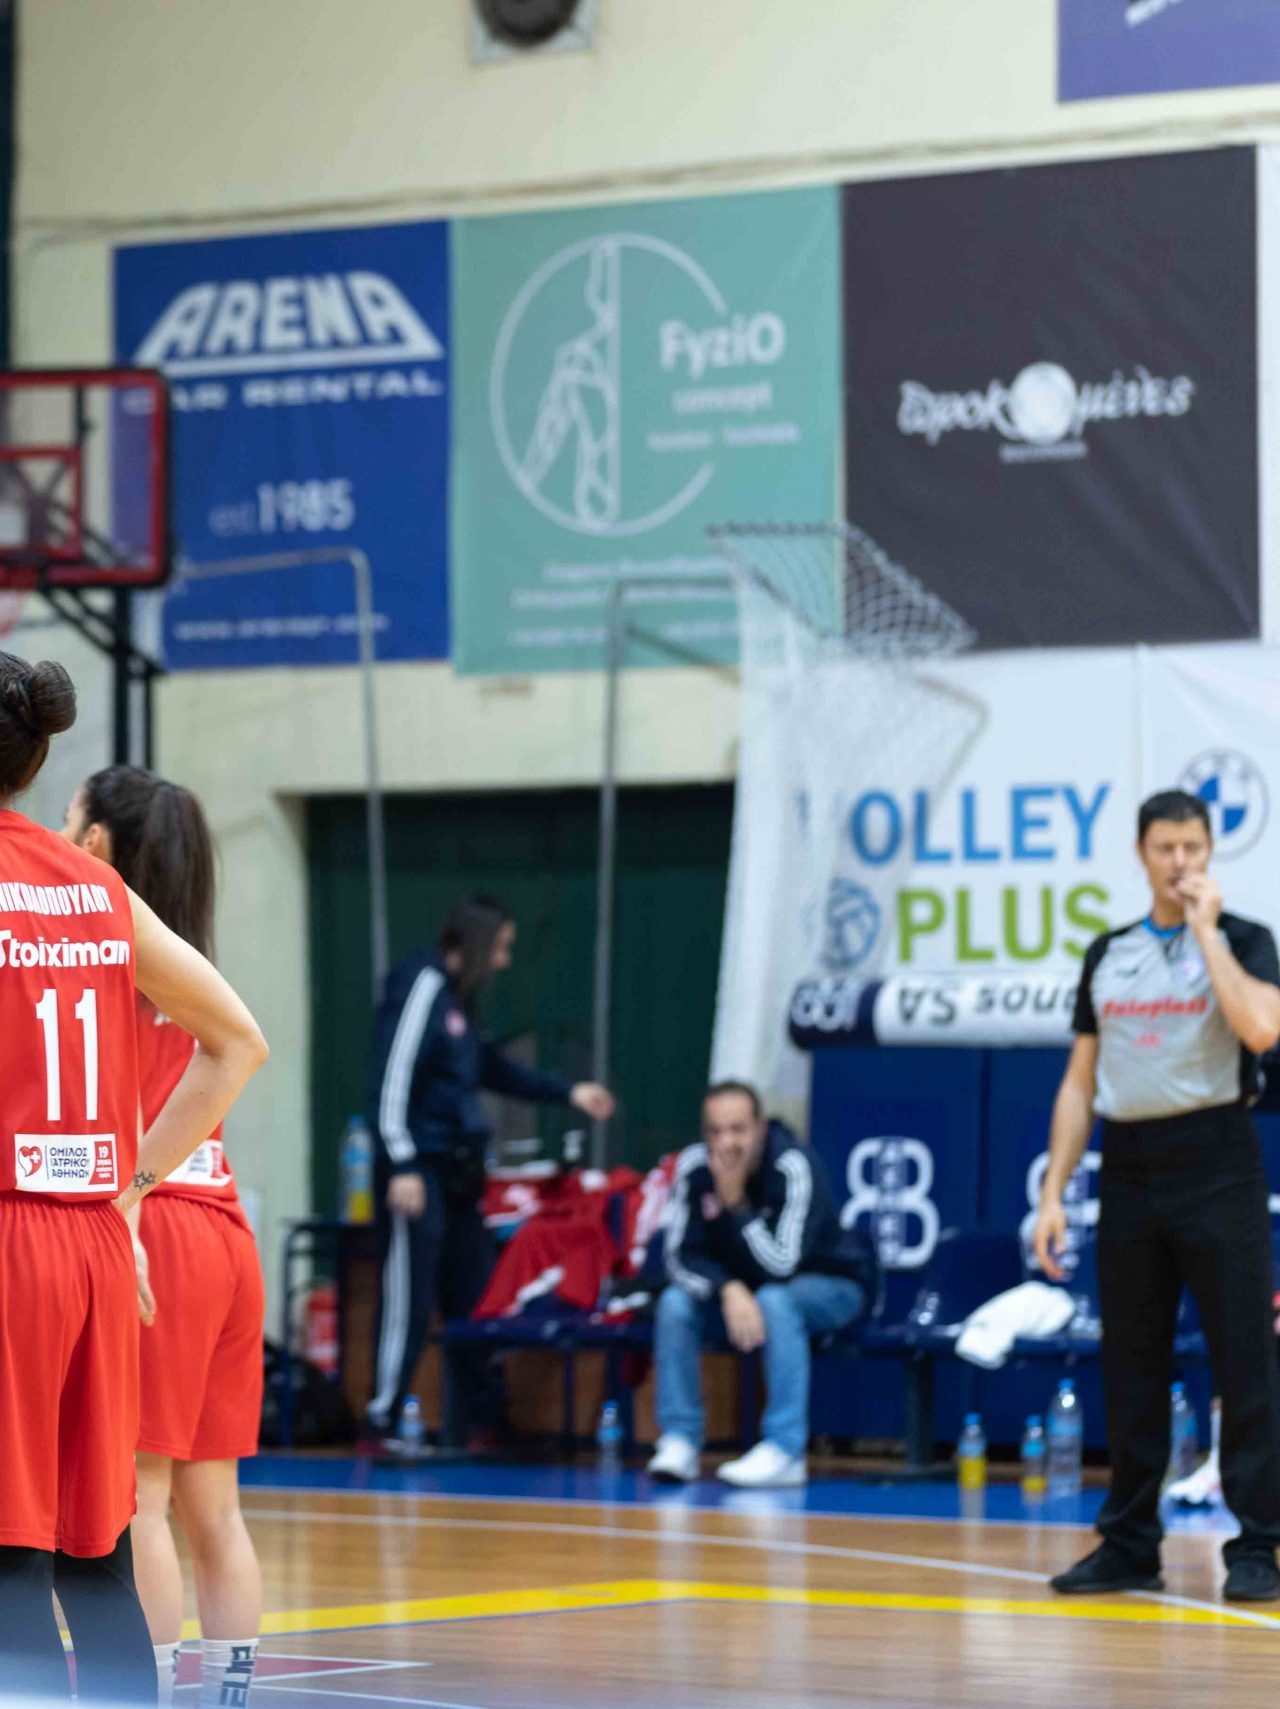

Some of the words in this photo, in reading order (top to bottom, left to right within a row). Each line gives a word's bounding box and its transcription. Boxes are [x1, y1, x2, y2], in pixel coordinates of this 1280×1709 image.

[132, 268, 444, 378] ARENA
[241, 370, 445, 407] RENTAL
[848, 782, 1111, 866] OLLEY
[894, 881, 1111, 965] PLUS
[35, 988, 98, 1121] 11
[49, 1147, 88, 1157] ΟΜΙΛΟΣ
[51, 1168, 90, 1178] ΑΘΗΝΩΝ
[98, 1145, 109, 1159] 19
